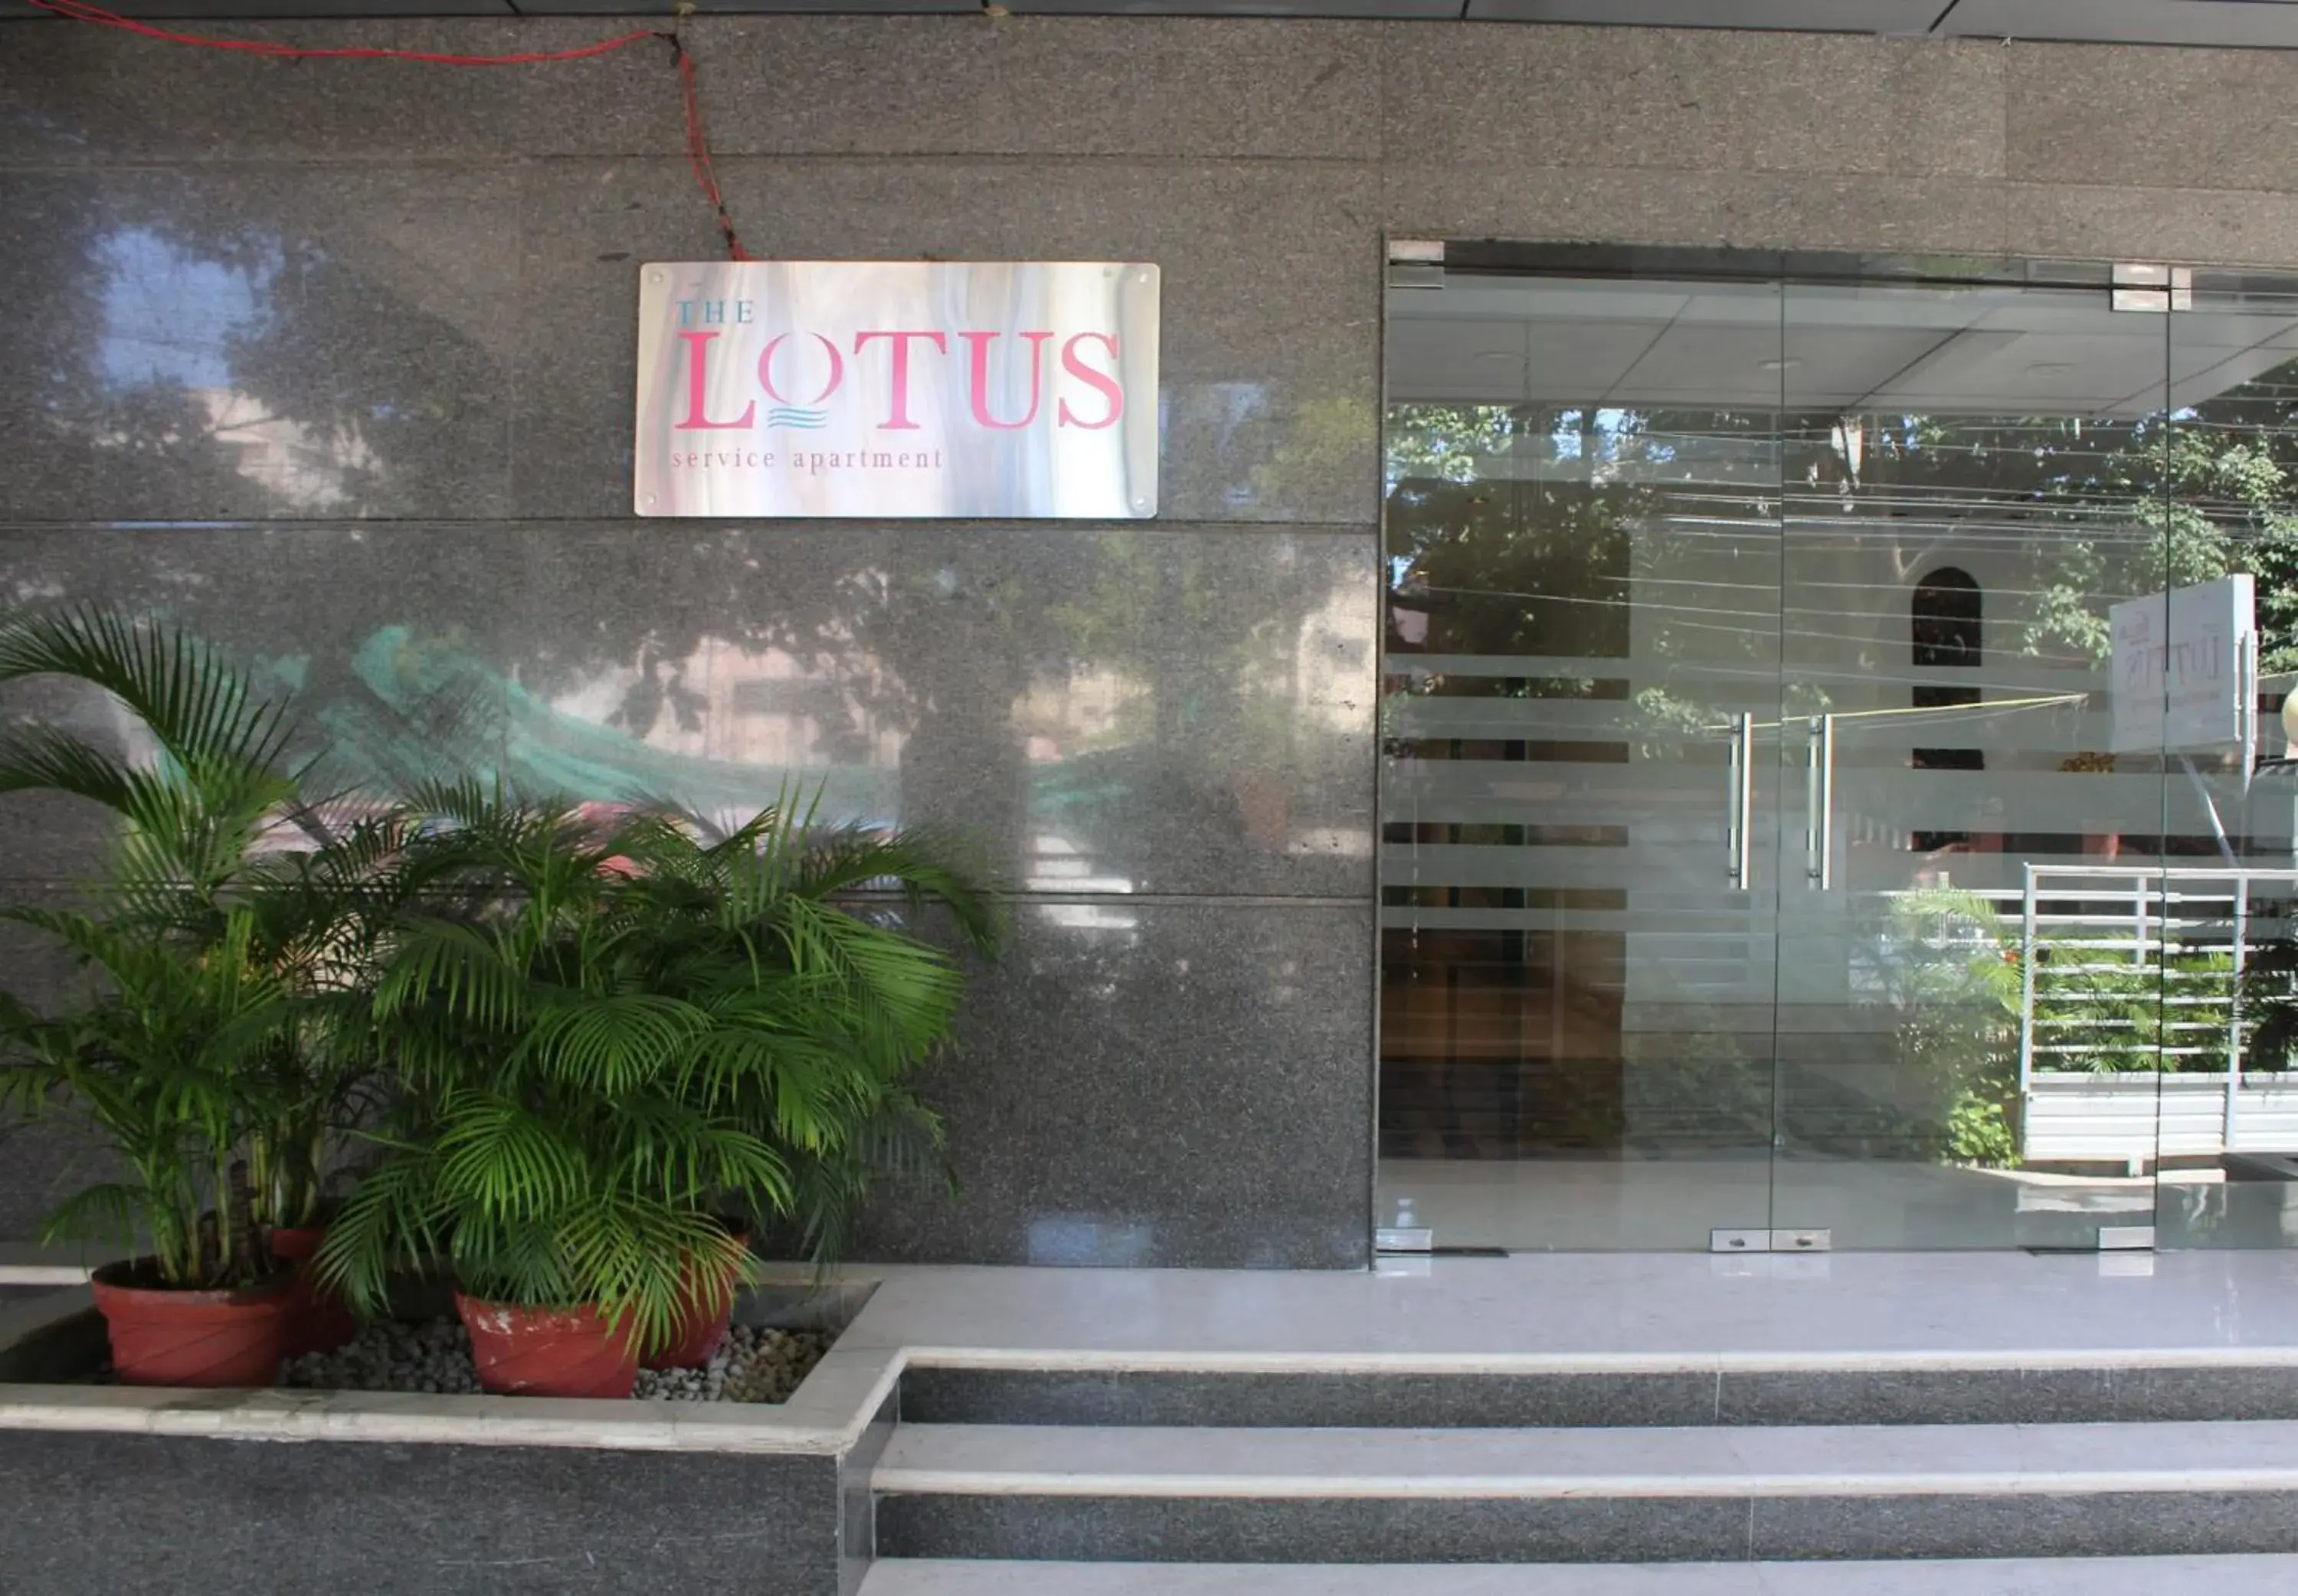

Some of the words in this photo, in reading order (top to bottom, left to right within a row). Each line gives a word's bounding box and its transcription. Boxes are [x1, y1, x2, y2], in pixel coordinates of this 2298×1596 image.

[676, 299, 755, 323] THE
[674, 331, 1124, 430] LOTUS
[673, 448, 775, 468] service
[794, 449, 943, 474] apartment
